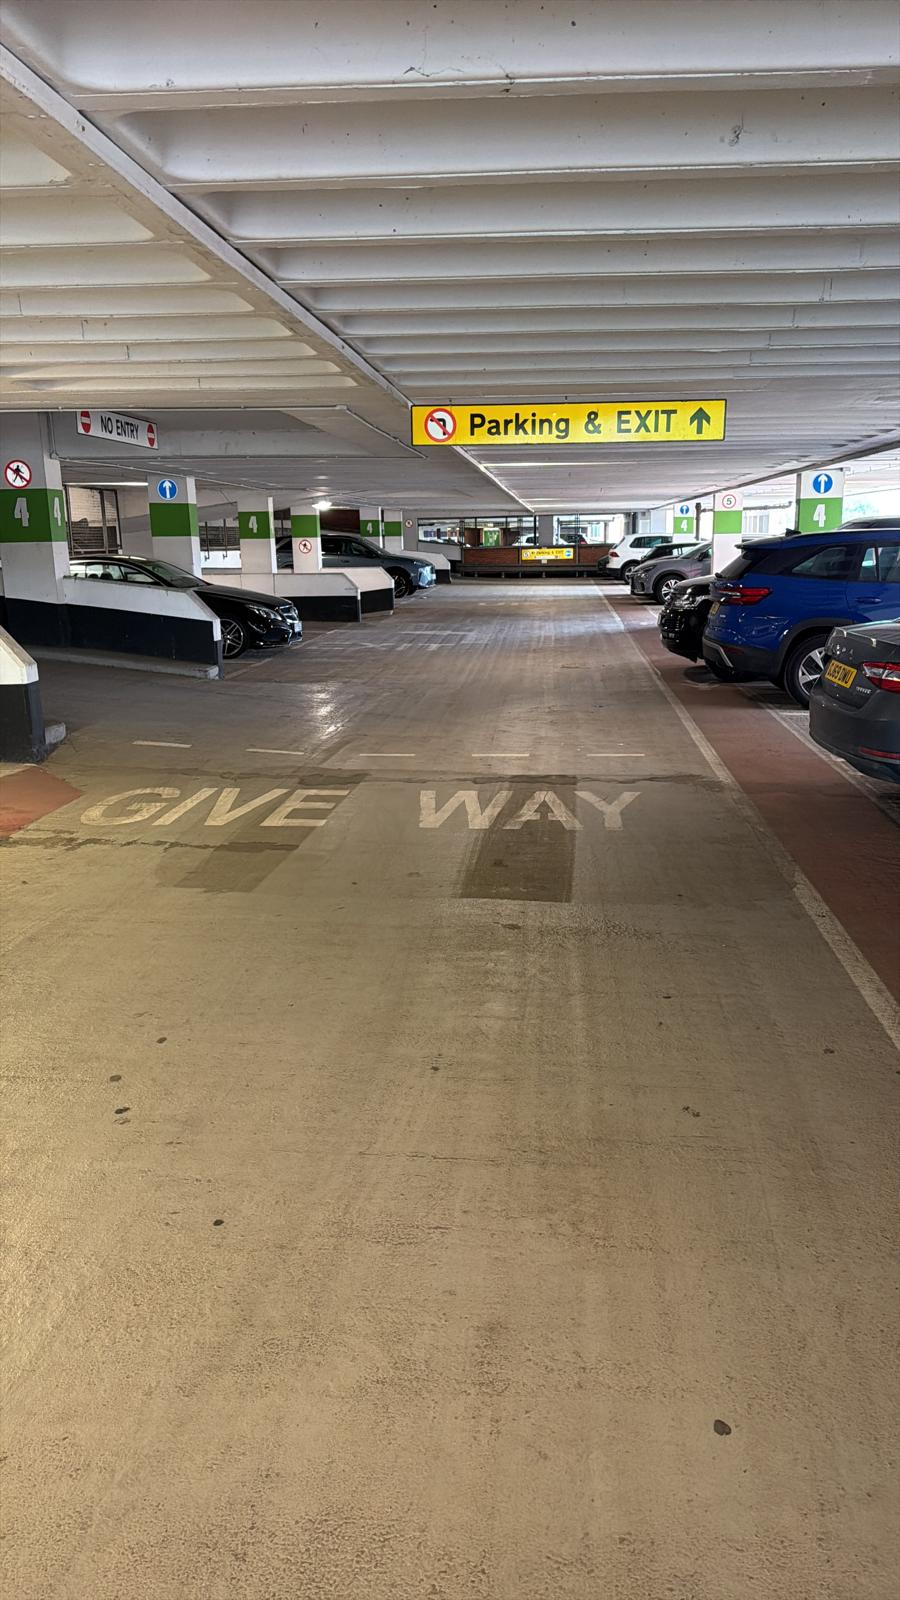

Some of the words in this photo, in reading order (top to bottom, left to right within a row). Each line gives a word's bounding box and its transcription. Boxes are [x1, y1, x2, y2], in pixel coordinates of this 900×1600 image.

[100, 415, 114, 435] NO
[116, 422, 140, 441] ENTRY
[469, 412, 570, 440] Parking
[584, 411, 602, 435] &
[617, 409, 678, 434] EXIT
[14, 497, 30, 527] 4
[53, 496, 62, 527] 4
[248, 515, 258, 533] 4
[812, 503, 826, 528] 4
[366, 522, 373, 534] 4
[680, 519, 688, 532] 4
[80, 786, 351, 828] GIVE
[418, 789, 641, 831] WAY
